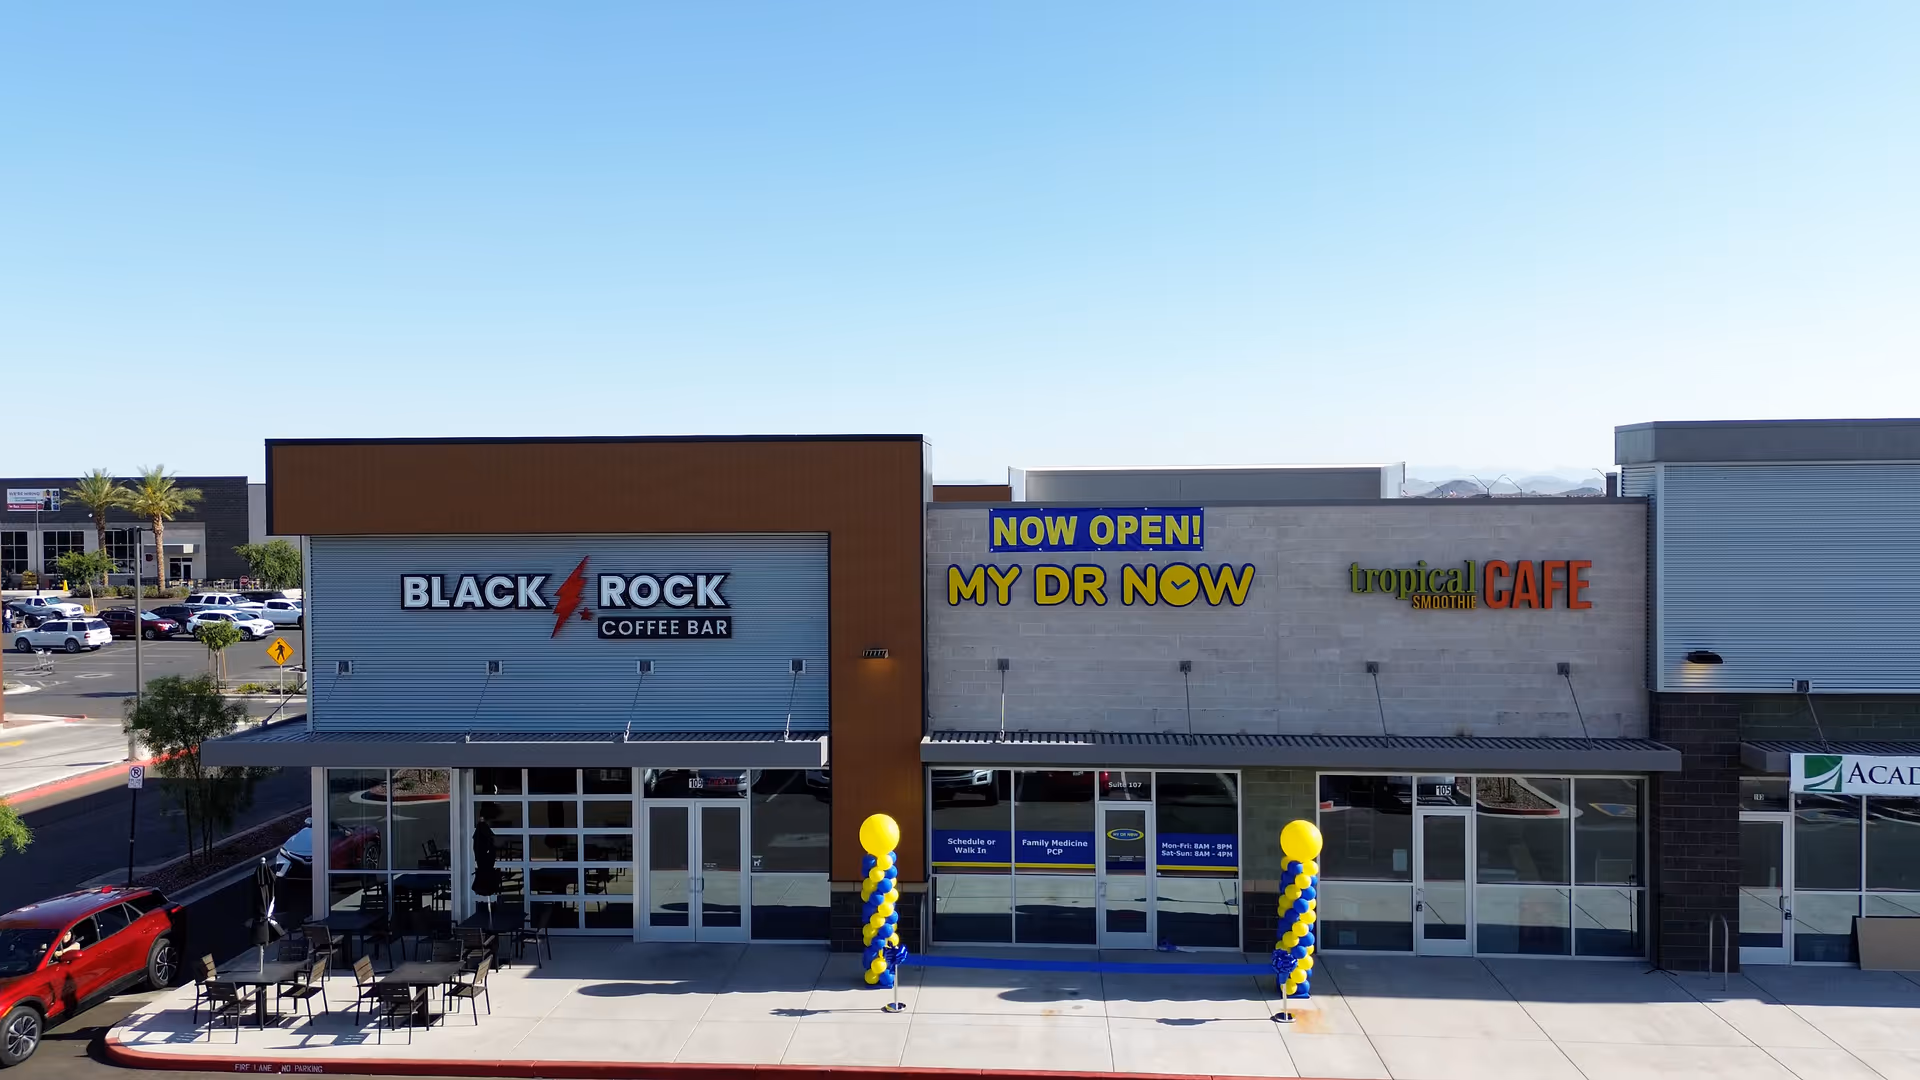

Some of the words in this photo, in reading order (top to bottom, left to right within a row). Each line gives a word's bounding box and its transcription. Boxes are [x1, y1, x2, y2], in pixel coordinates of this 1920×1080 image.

[993, 515, 1078, 546] NOW
[1089, 515, 1201, 545] OPEN!
[948, 564, 1022, 606] MY
[1034, 564, 1107, 606] DR
[1121, 562, 1255, 607] NOW
[1349, 560, 1476, 599] tropical
[1484, 560, 1592, 609] CAFE
[402, 574, 550, 609] BLACK
[598, 573, 731, 609] ROCK
[1412, 595, 1477, 609] SMOOTHIE
[602, 620, 679, 635] COFFEE
[687, 620, 728, 635] BAR
[1436, 785, 1451, 795] 105
[947, 838, 985, 846] Schedule
[1022, 839, 1049, 847] Family
[235, 1063, 251, 1071] FIRE
[254, 1064, 272, 1072] LANE
[294, 1065, 323, 1073] PARKING
